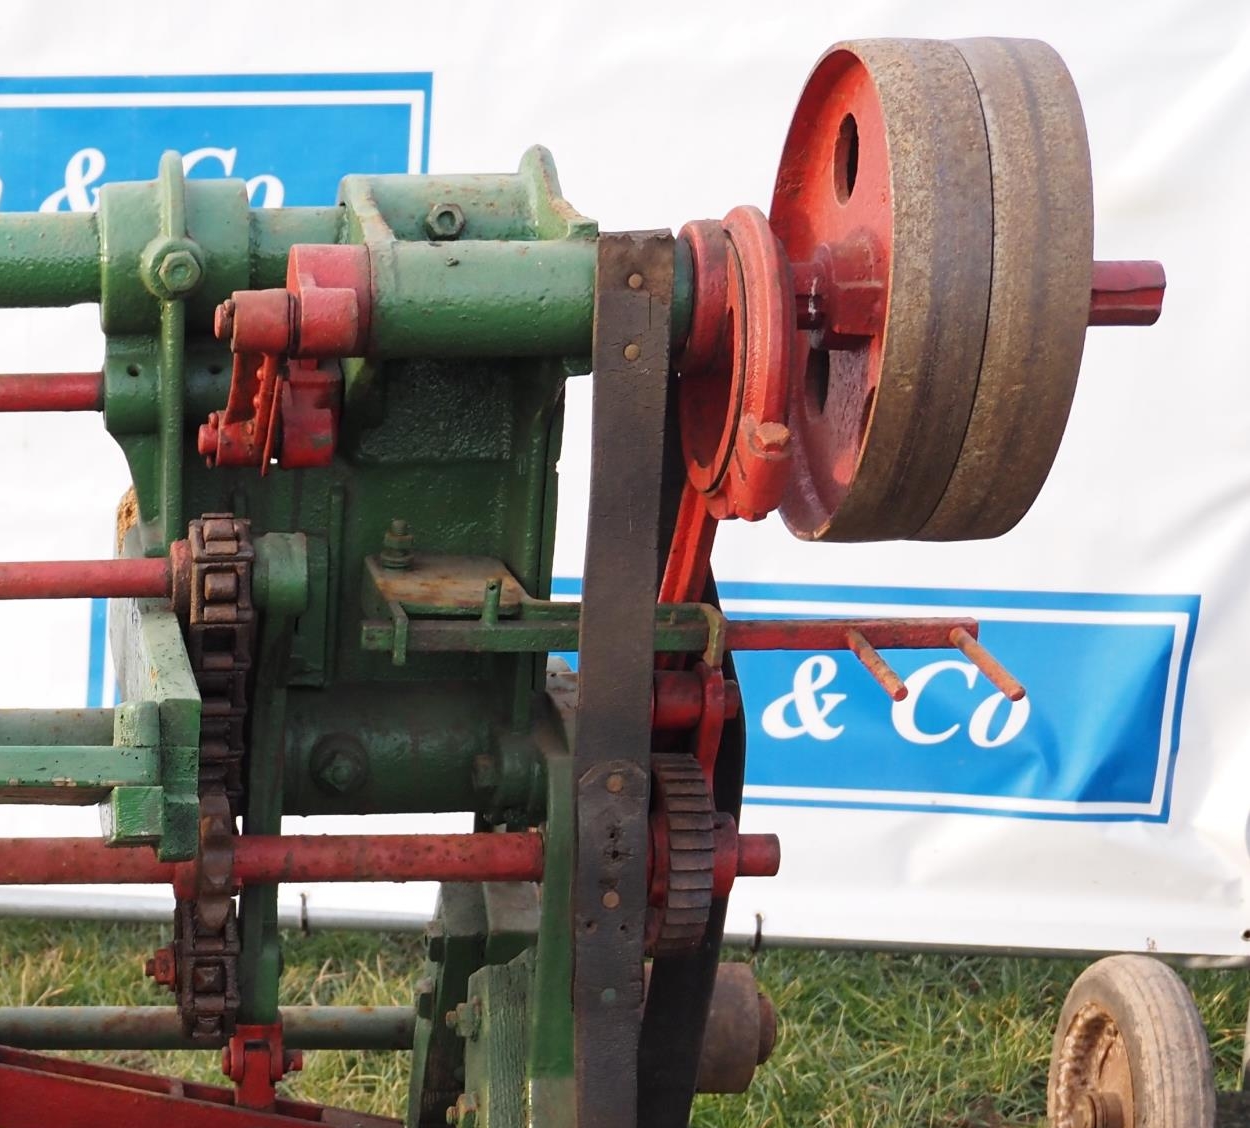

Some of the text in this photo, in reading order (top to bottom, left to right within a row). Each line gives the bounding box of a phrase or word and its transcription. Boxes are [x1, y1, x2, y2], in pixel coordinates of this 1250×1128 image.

[38, 147, 106, 213] &
[760, 655, 1031, 749] & Co
